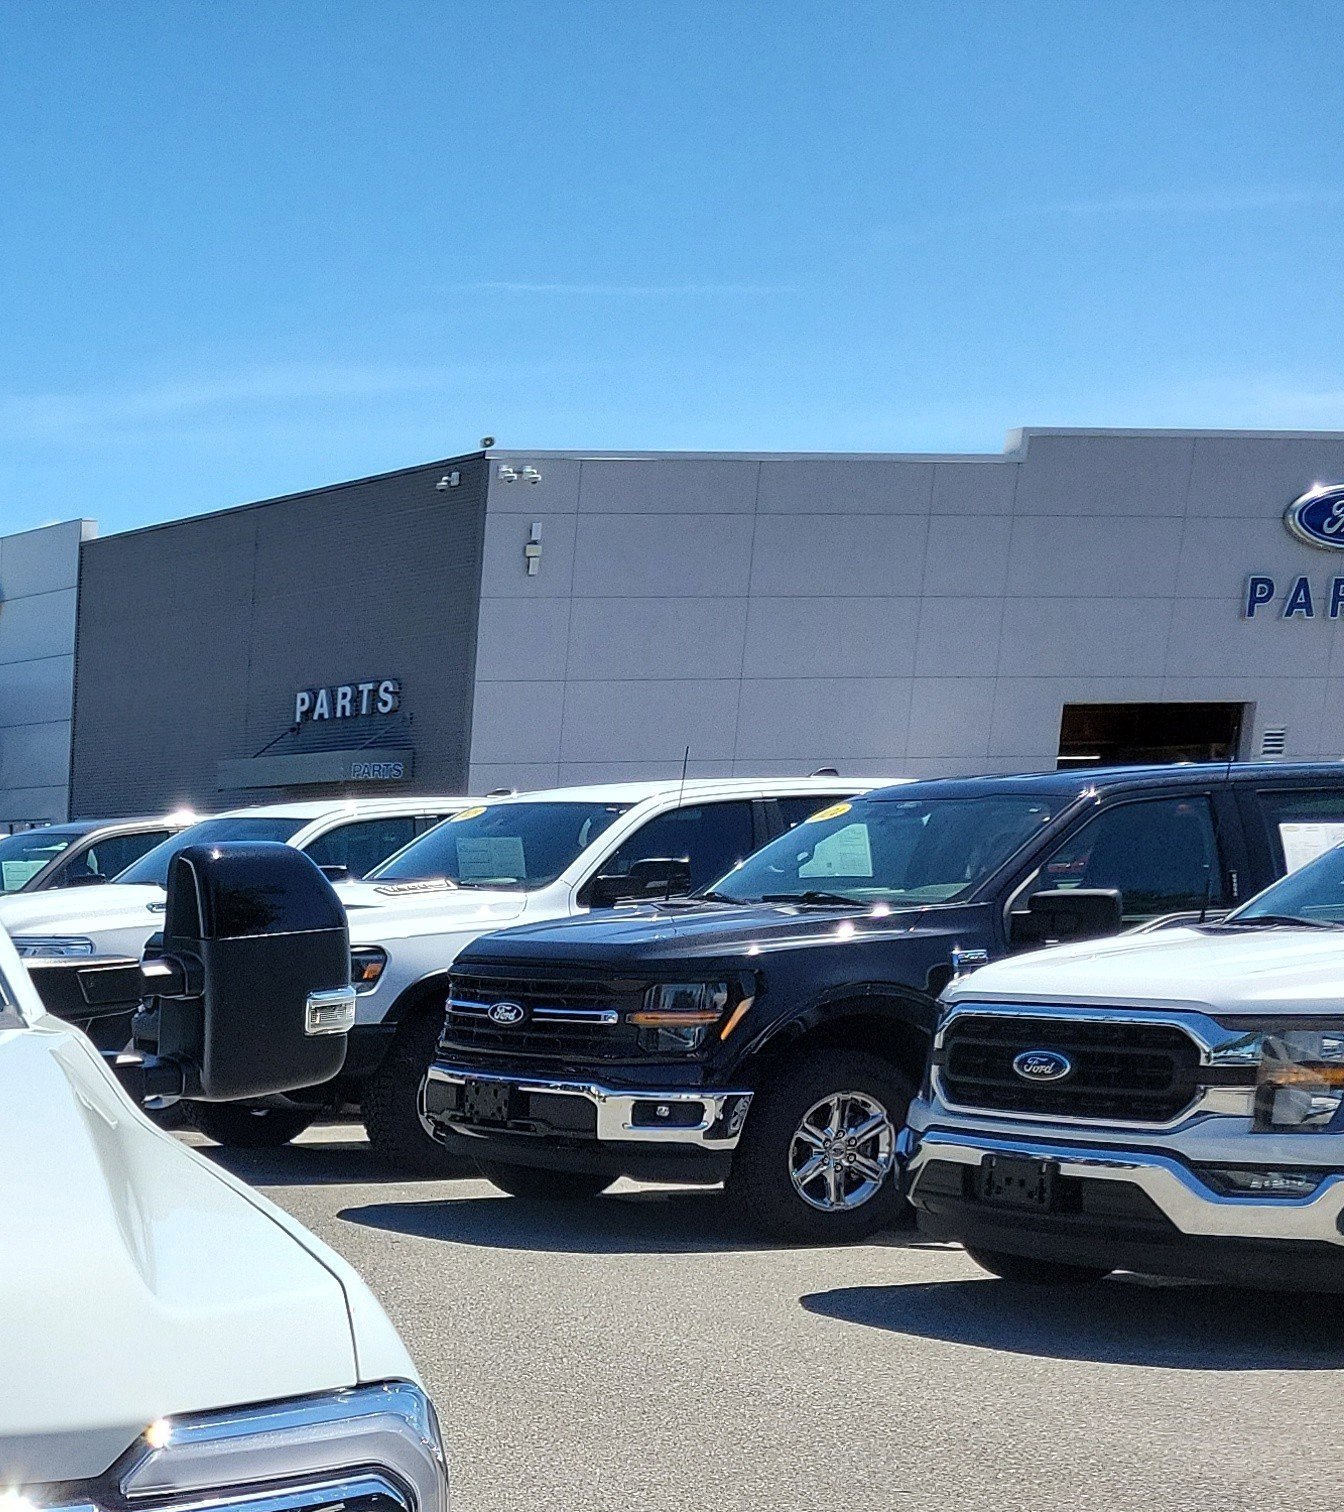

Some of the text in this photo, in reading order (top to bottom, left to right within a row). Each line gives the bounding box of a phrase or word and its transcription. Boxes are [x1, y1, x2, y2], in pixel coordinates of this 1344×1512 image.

[295, 680, 394, 722] PARTS
[352, 763, 404, 779] PARTS
[494, 1005, 517, 1020] Ford
[1023, 1056, 1056, 1074] Ford
